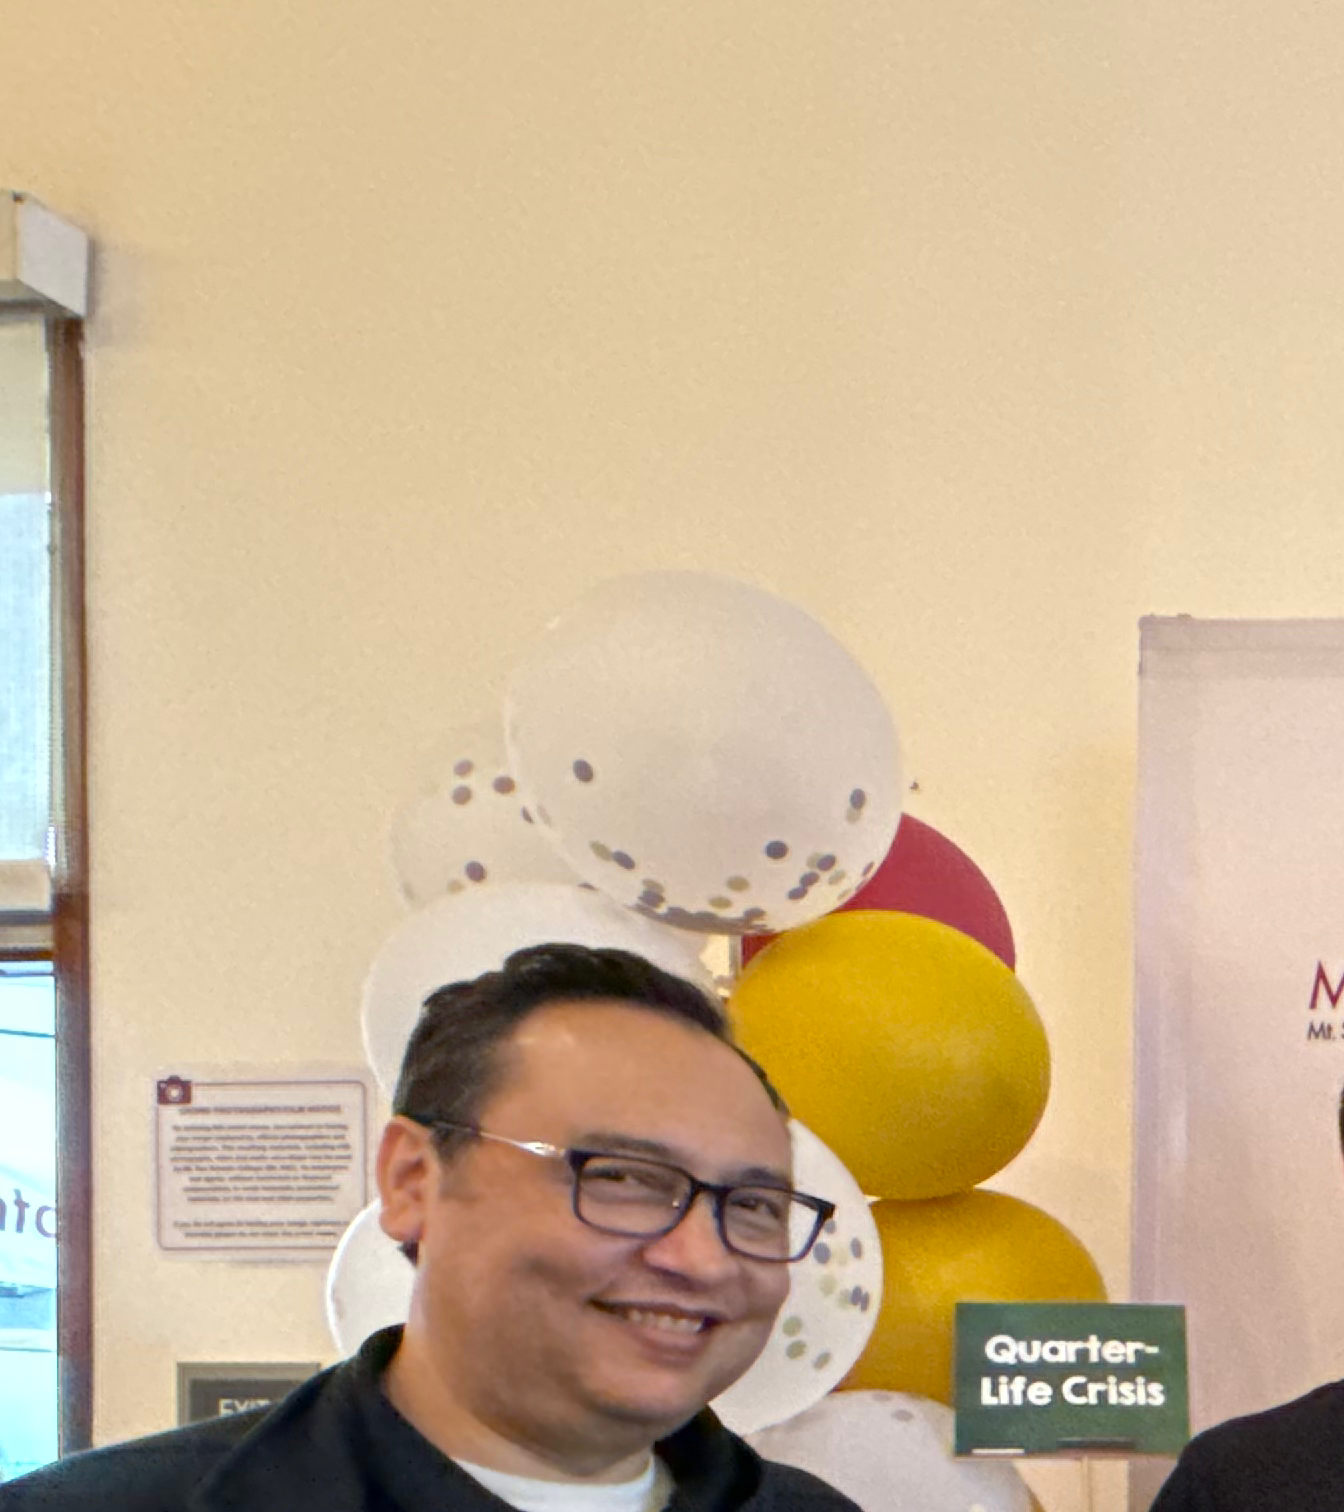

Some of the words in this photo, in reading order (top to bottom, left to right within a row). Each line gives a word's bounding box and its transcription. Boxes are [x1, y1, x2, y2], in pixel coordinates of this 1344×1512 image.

[1307, 1021, 1336, 1041] Mt.
[984, 1335, 1160, 1367] Quarter-
[980, 1374, 1054, 1407] Life
[1061, 1373, 1166, 1407] Crisis
